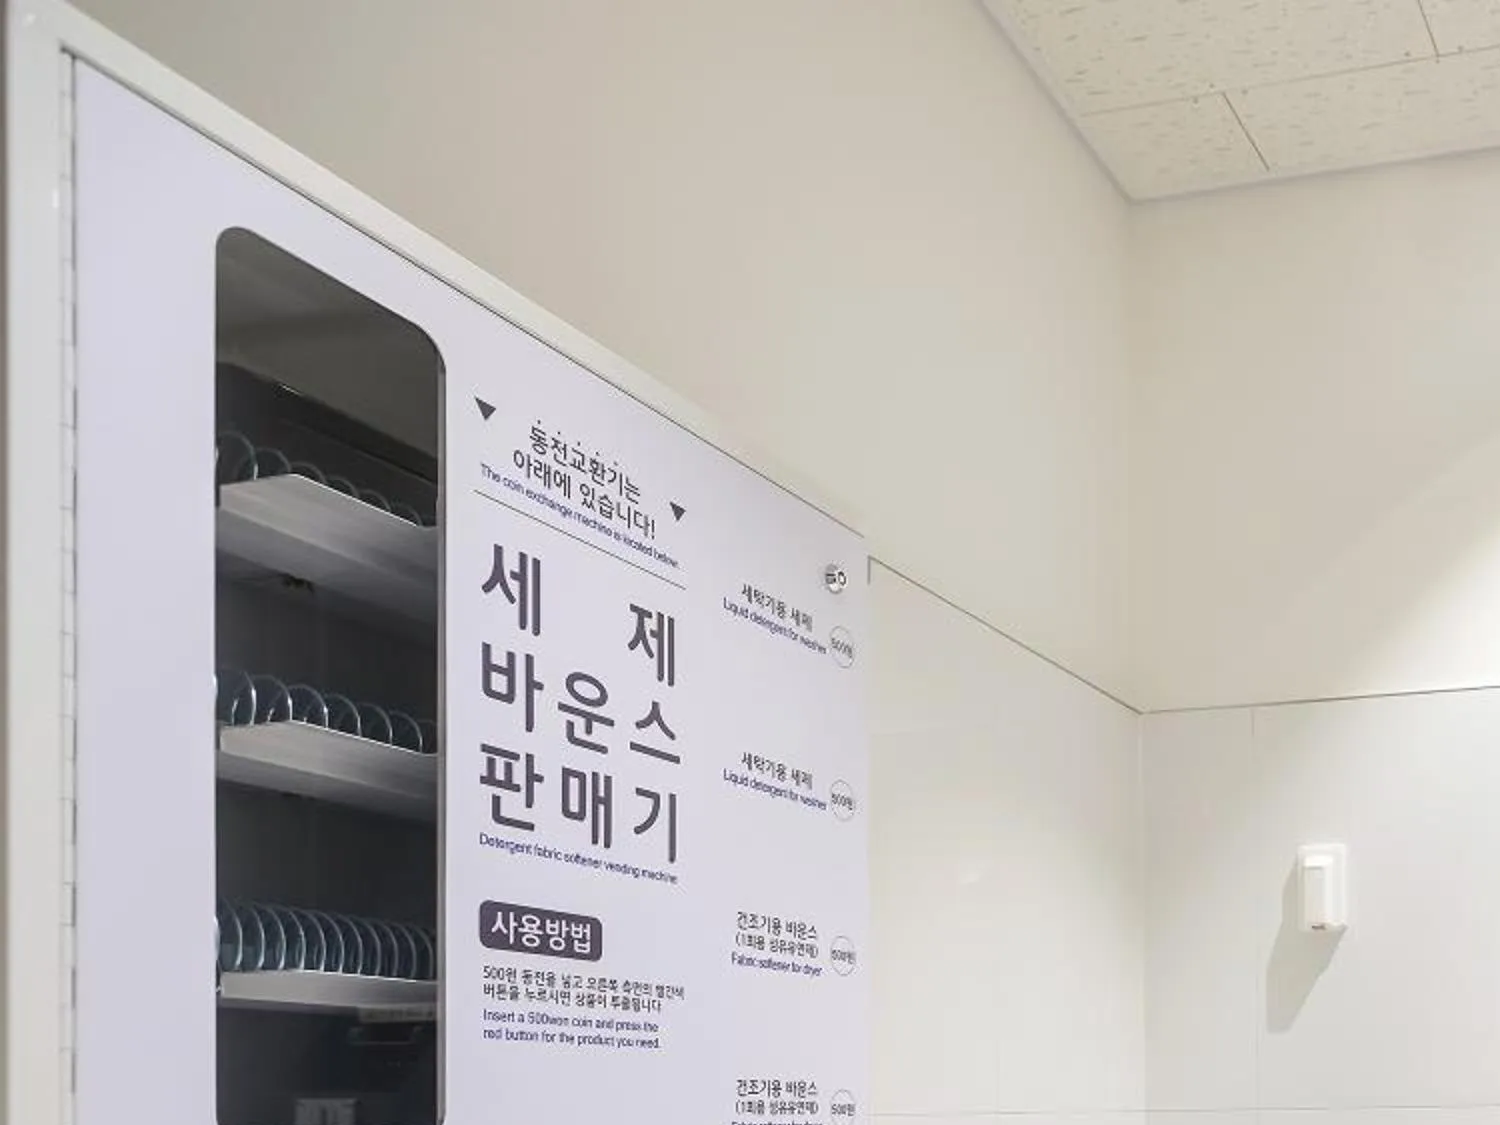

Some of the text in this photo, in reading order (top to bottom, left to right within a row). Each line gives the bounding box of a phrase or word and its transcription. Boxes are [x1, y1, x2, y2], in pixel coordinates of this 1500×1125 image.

[530, 423, 641, 505] 동전교환기는
[481, 462, 500, 483] The
[502, 475, 525, 496] coin
[525, 487, 573, 521] exchange
[513, 450, 656, 540] 아래에 있습니다!
[481, 641, 681, 764] 바운스
[480, 742, 678, 864] 판매기
[479, 832, 533, 857] Detergent
[534, 843, 562, 862] fabric
[491, 911, 591, 954] 사용방법
[483, 965, 517, 984] 500원
[522, 969, 556, 987] 동전을
[562, 974, 583, 989] 넣고
[586, 976, 617, 992] 오른쪽
[483, 984, 607, 1009] 버튼을 누르시면 상품이
[483, 1009, 515, 1023] Insert
[528, 1012, 569, 1026] 500won
[571, 1016, 593, 1029] coin
[595, 1018, 615, 1030] and
[483, 1027, 502, 1040] red
[505, 1028, 539, 1042] button
[559, 1031, 575, 1044] the
[577, 1032, 615, 1048] product
[617, 1035, 635, 1049] you
